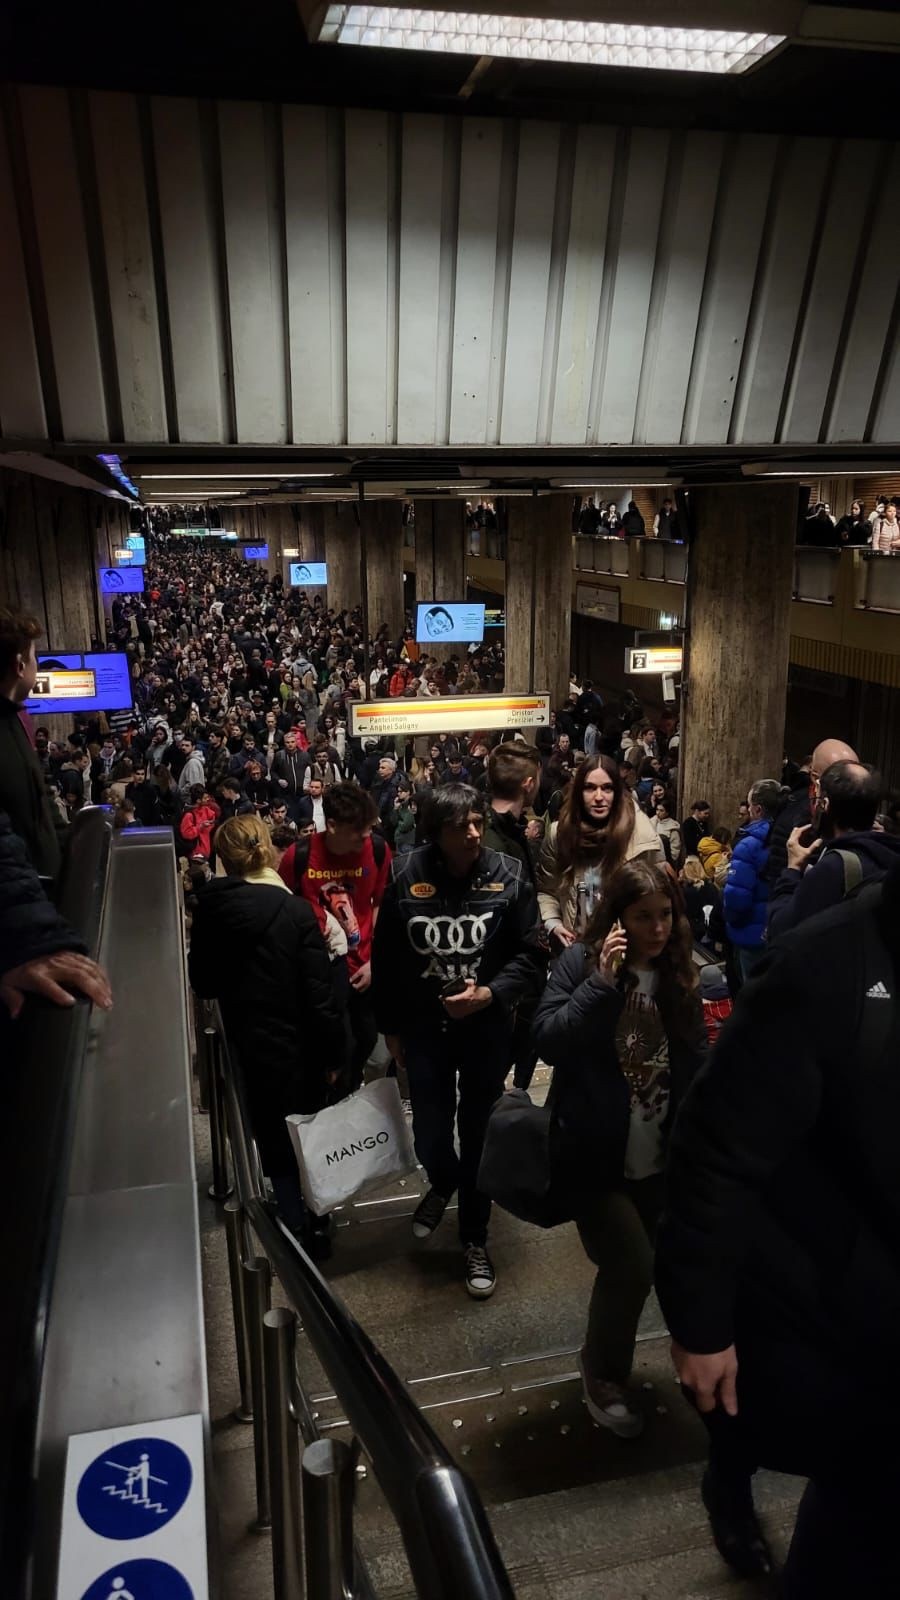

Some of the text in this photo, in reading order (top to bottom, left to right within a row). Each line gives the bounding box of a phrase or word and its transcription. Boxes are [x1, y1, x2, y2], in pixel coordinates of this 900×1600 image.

[635, 657, 643, 668] 2
[37, 682, 43, 692] 1
[369, 715, 408, 724] Pantelimon
[369, 721, 419, 732] Anghel Saligny
[325, 1131, 389, 1166] MANGO
